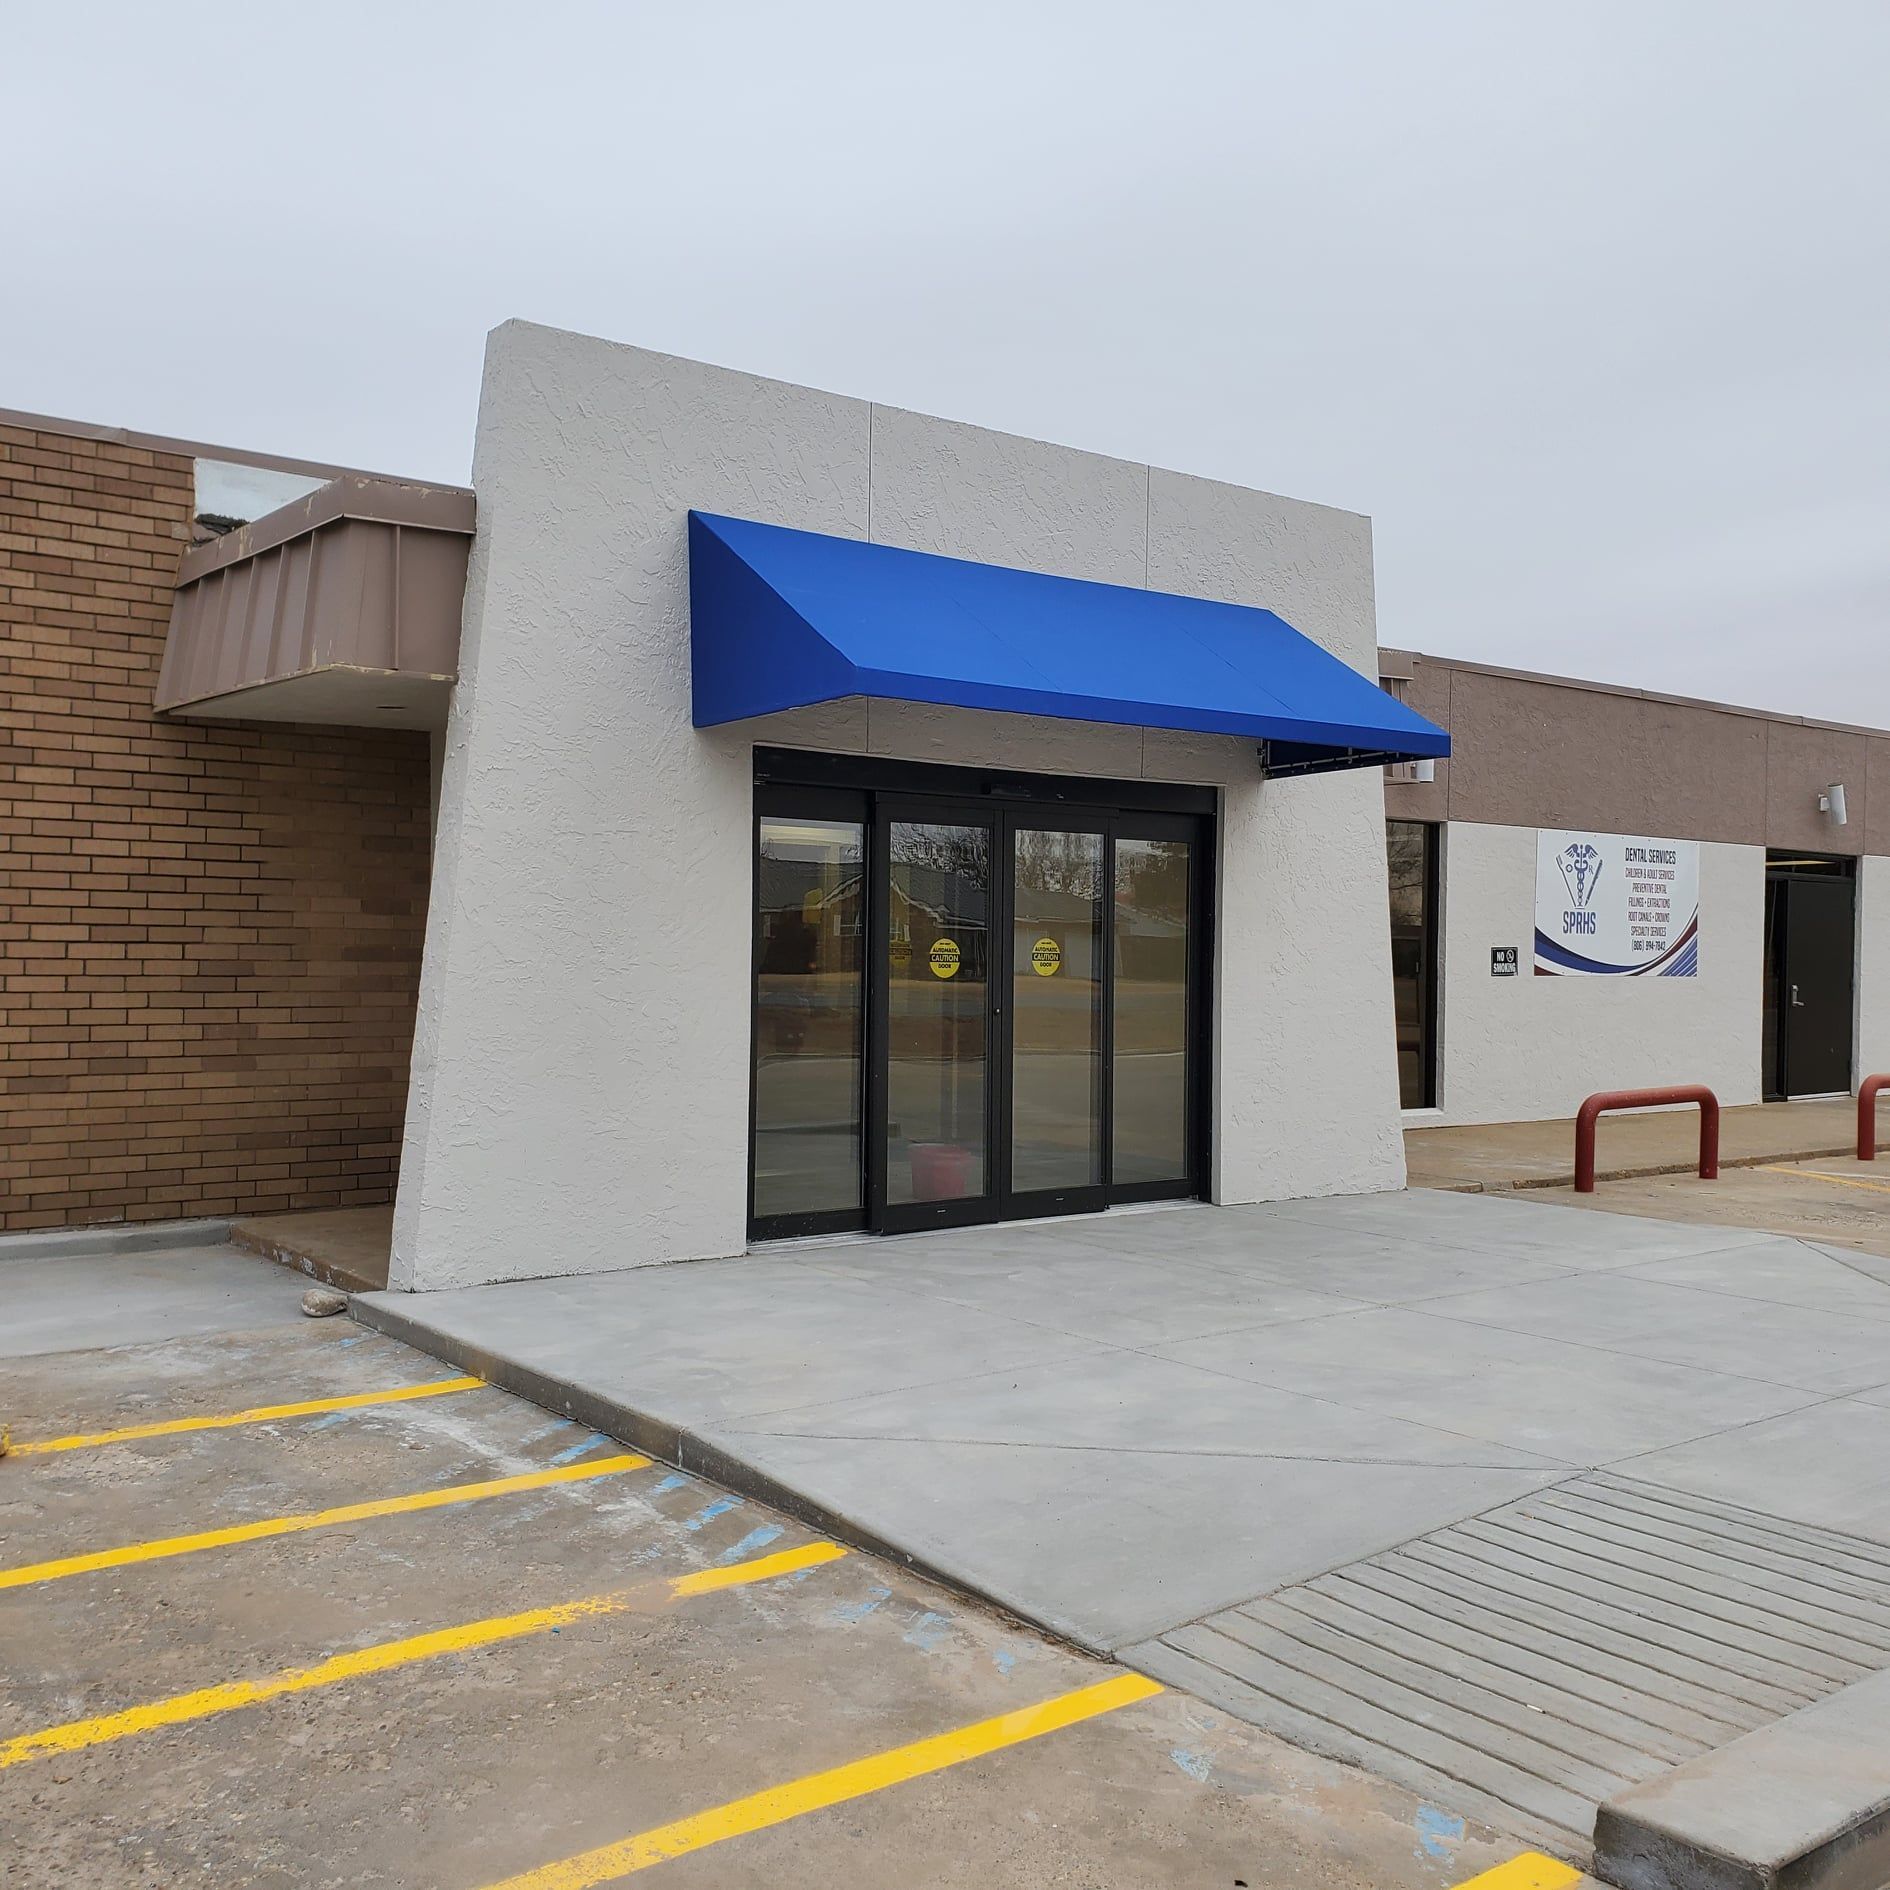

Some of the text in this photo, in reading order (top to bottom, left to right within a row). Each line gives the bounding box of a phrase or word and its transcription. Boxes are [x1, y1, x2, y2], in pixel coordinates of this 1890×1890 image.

[1625, 847, 1676, 864] DENTAL SERVICES
[1625, 867, 1643, 878] CHILDREN
[1647, 868, 1658, 879] ADULT
[1658, 869, 1675, 880] SERVICES
[1632, 882, 1667, 894] PREVENTIVE DENTAL
[1562, 910, 1596, 935] SPRHS
[931, 954, 959, 962] CAUTION
[1033, 953, 1059, 961] CAUTION
[1496, 951, 1505, 962] NO
[1493, 962, 1516, 973] SMOKING
